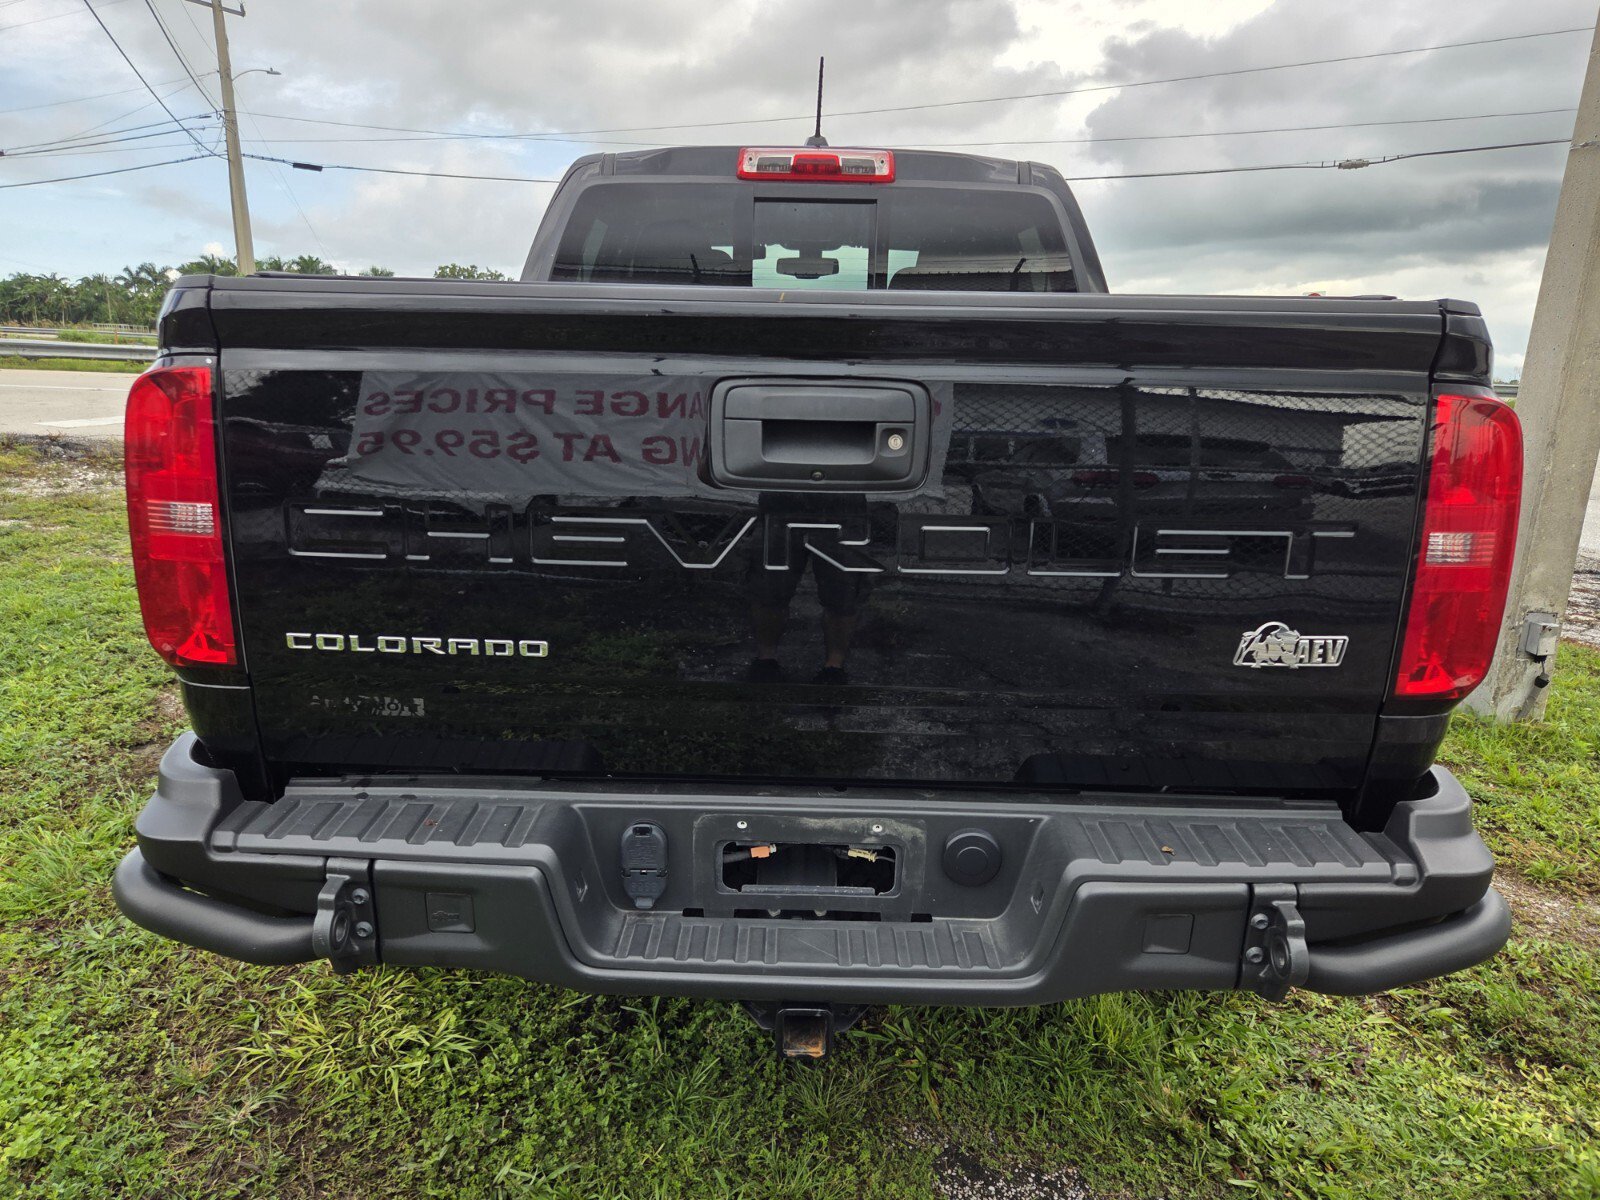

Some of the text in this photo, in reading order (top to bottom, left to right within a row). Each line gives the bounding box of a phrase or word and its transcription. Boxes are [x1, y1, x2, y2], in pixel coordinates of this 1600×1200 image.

[286, 500, 1357, 580] CHEVROLET
[286, 632, 549, 658] COLORADO
[1295, 639, 1344, 664] AEV
